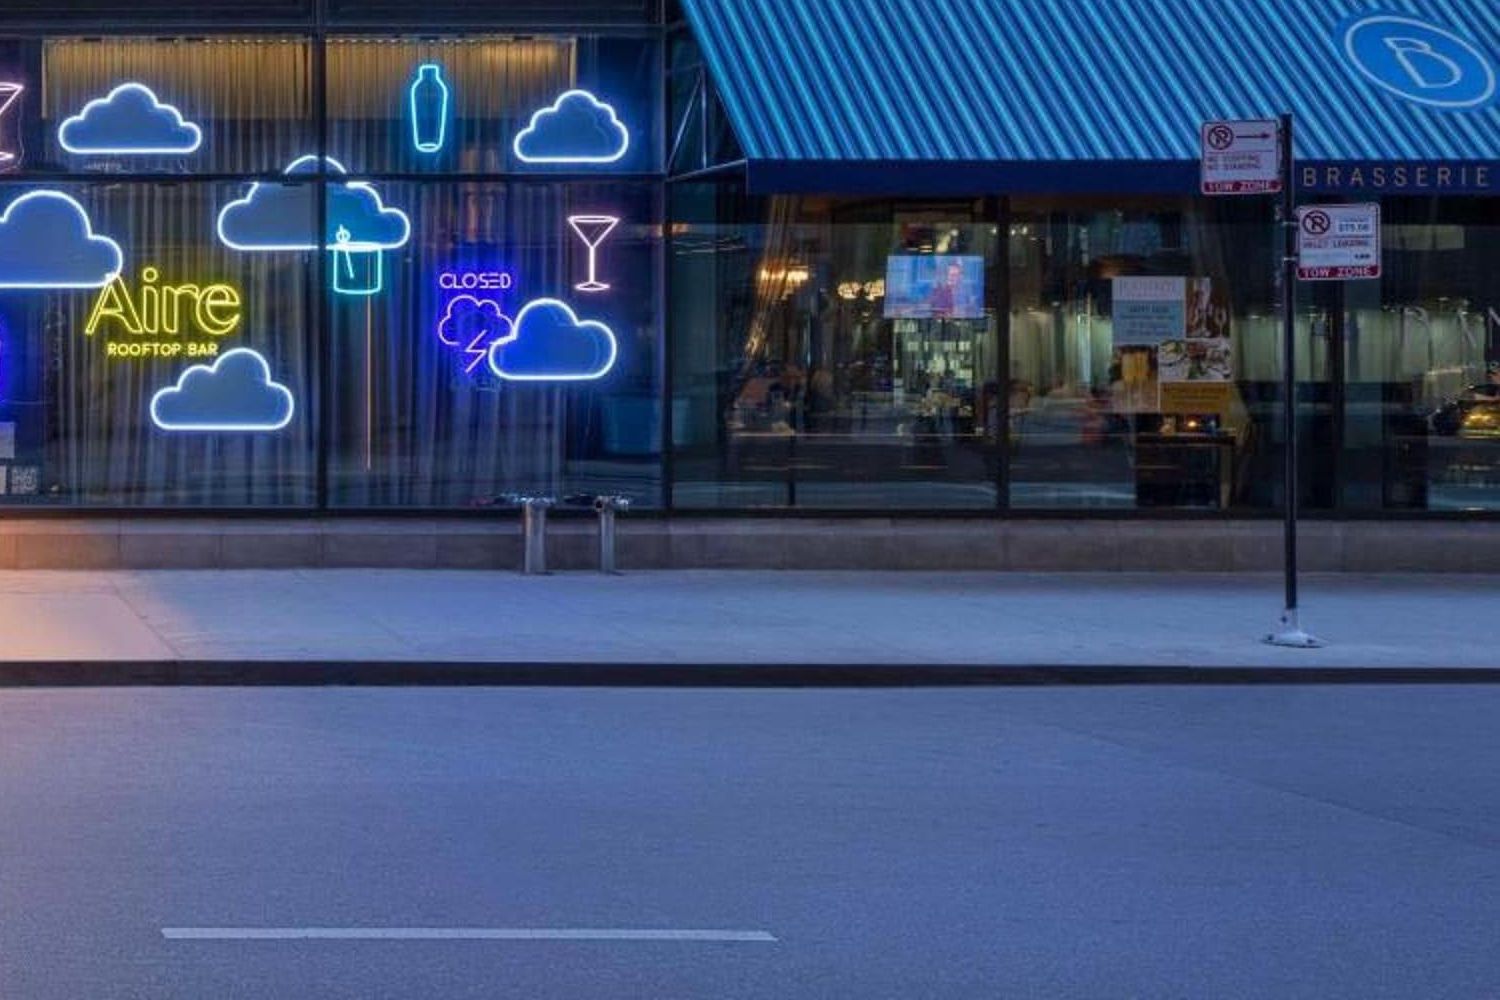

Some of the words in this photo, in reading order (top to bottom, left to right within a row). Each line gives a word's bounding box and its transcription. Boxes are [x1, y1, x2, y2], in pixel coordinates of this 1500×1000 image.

[1302, 167, 1490, 187] BRASSERIE
[1208, 182, 1236, 192] TOW
[1302, 268, 1331, 278] TOW
[1336, 266, 1372, 277] ZONE
[439, 272, 512, 289] CLOSED
[85, 267, 241, 335] Aire
[107, 343, 182, 356] ROOFTOP
[187, 343, 218, 356] BAR
